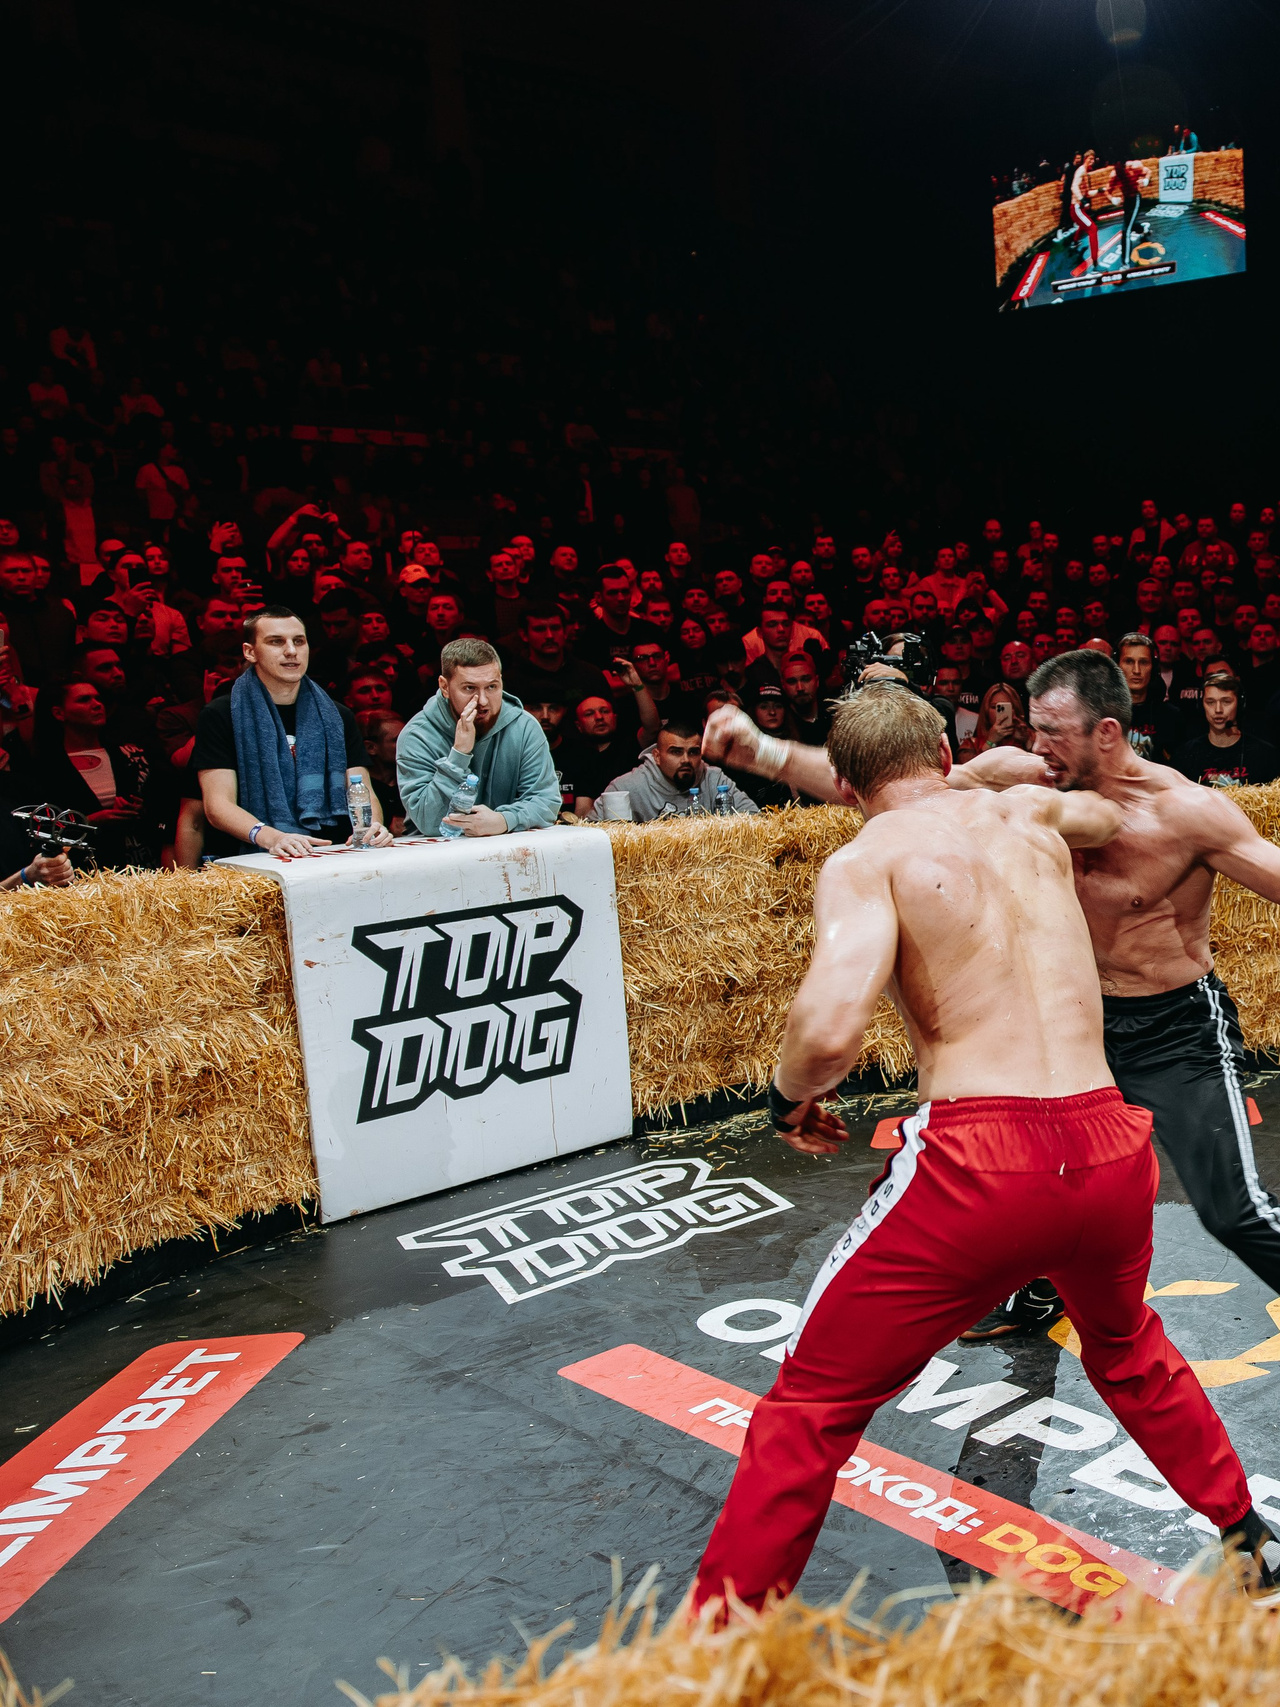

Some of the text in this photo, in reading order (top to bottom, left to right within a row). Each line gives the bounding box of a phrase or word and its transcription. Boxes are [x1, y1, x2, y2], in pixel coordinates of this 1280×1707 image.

[362, 903, 575, 1012] TOP
[362, 990, 573, 1109] DOG
[430, 1165, 690, 1249] TOP
[0, 1347, 242, 1568] IMPBET
[977, 1521, 1128, 1598] DOG
